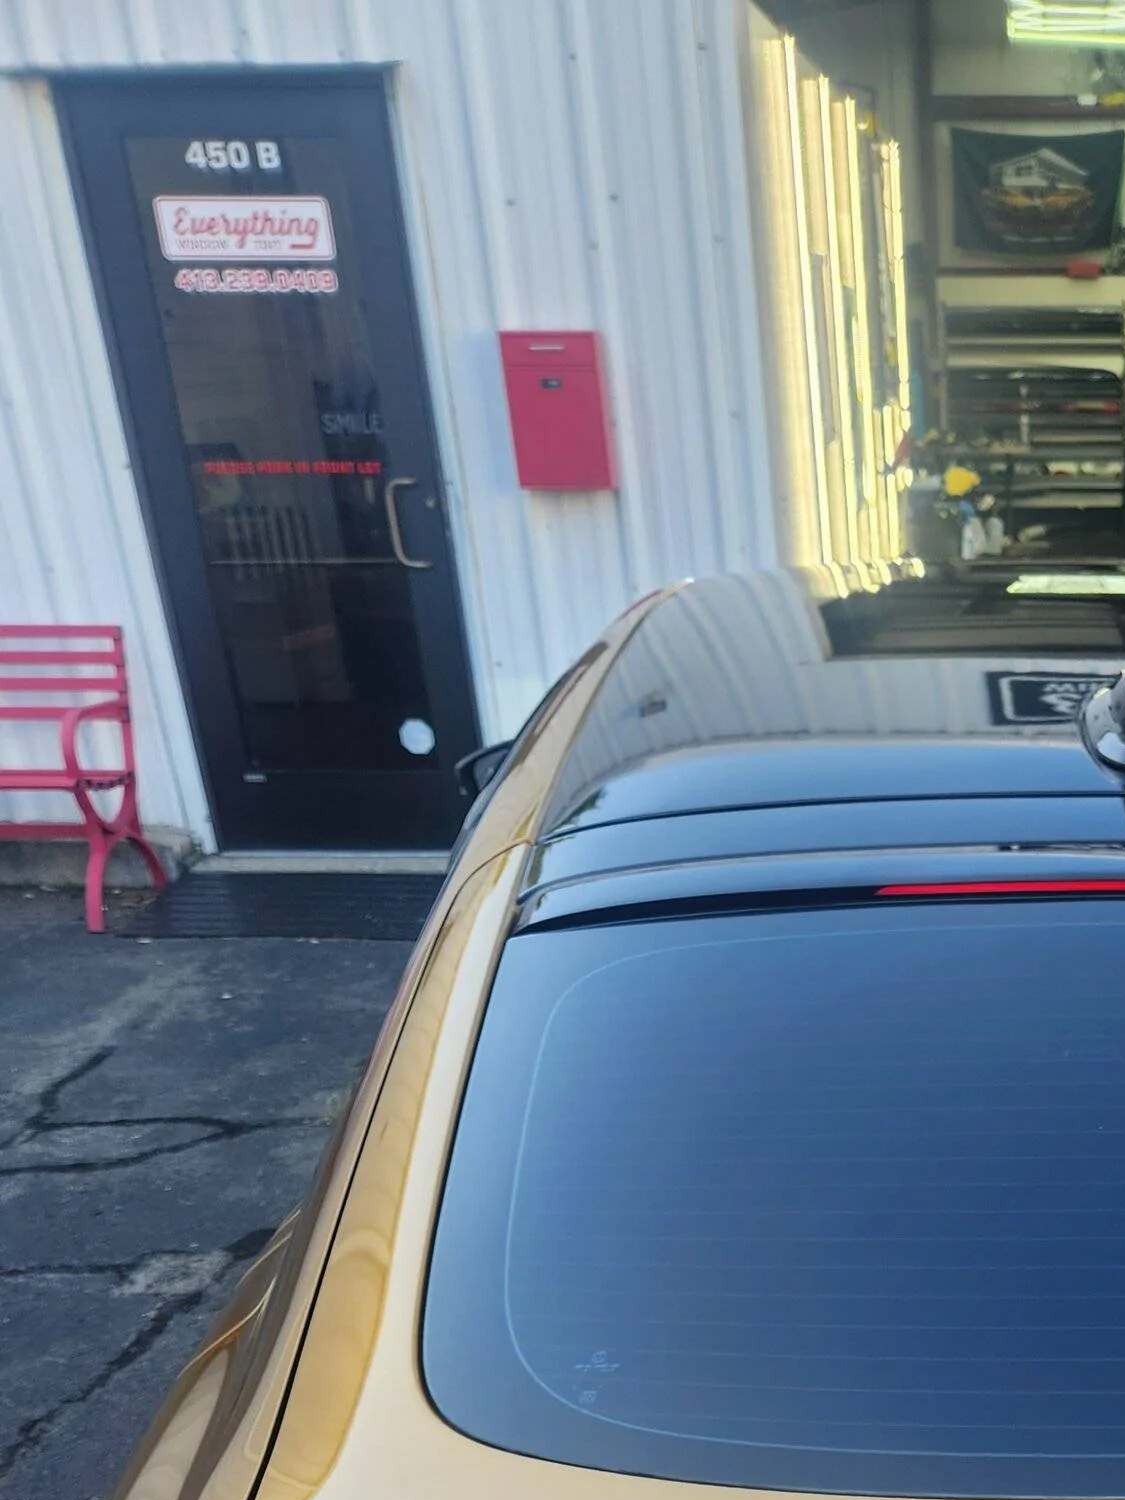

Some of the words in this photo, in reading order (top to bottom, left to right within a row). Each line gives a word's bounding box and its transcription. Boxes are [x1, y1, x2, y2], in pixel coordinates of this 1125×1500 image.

[185, 141, 250, 169] 450
[256, 141, 282, 169] B
[173, 206, 320, 249] Everything
